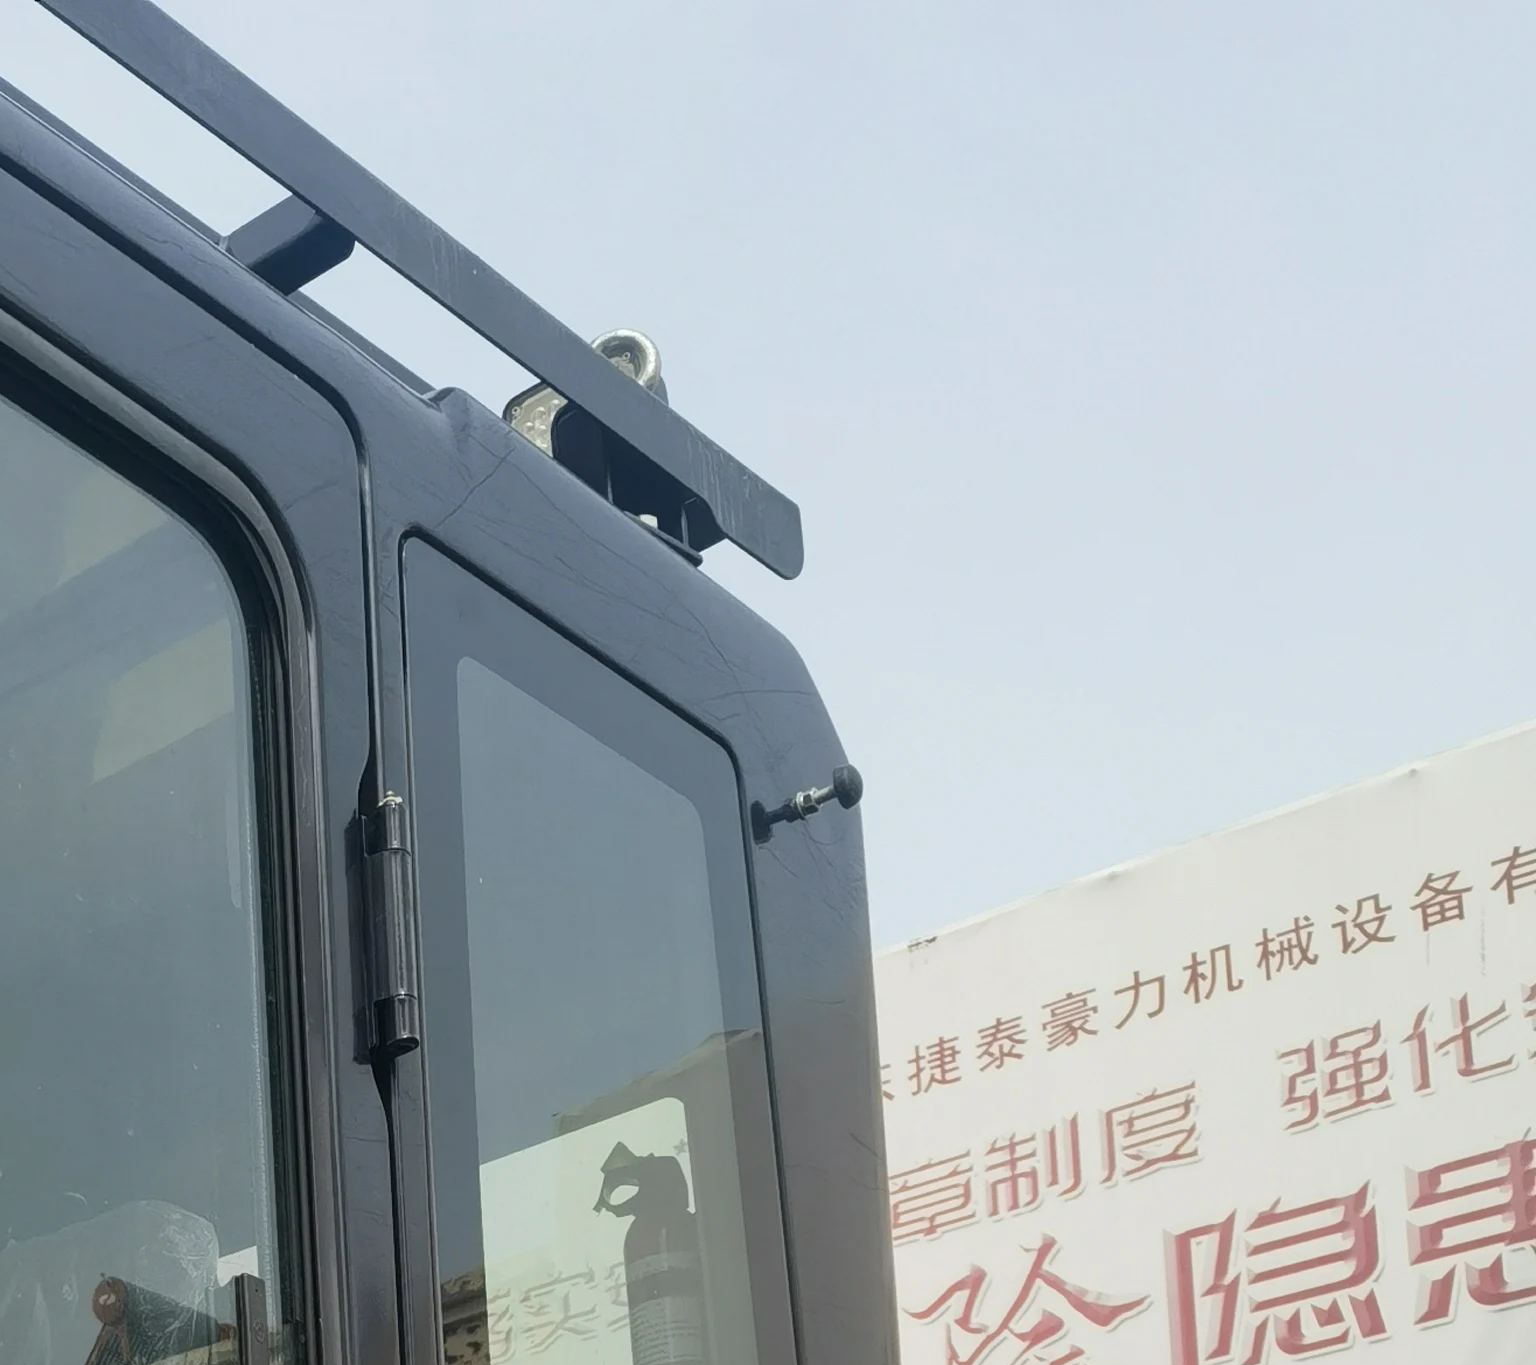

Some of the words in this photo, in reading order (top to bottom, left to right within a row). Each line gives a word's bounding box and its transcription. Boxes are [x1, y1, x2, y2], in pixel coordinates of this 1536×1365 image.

[879, 845, 1536, 1104] 捷泰豪力机械设备有
[1277, 982, 1536, 1134] 强化
